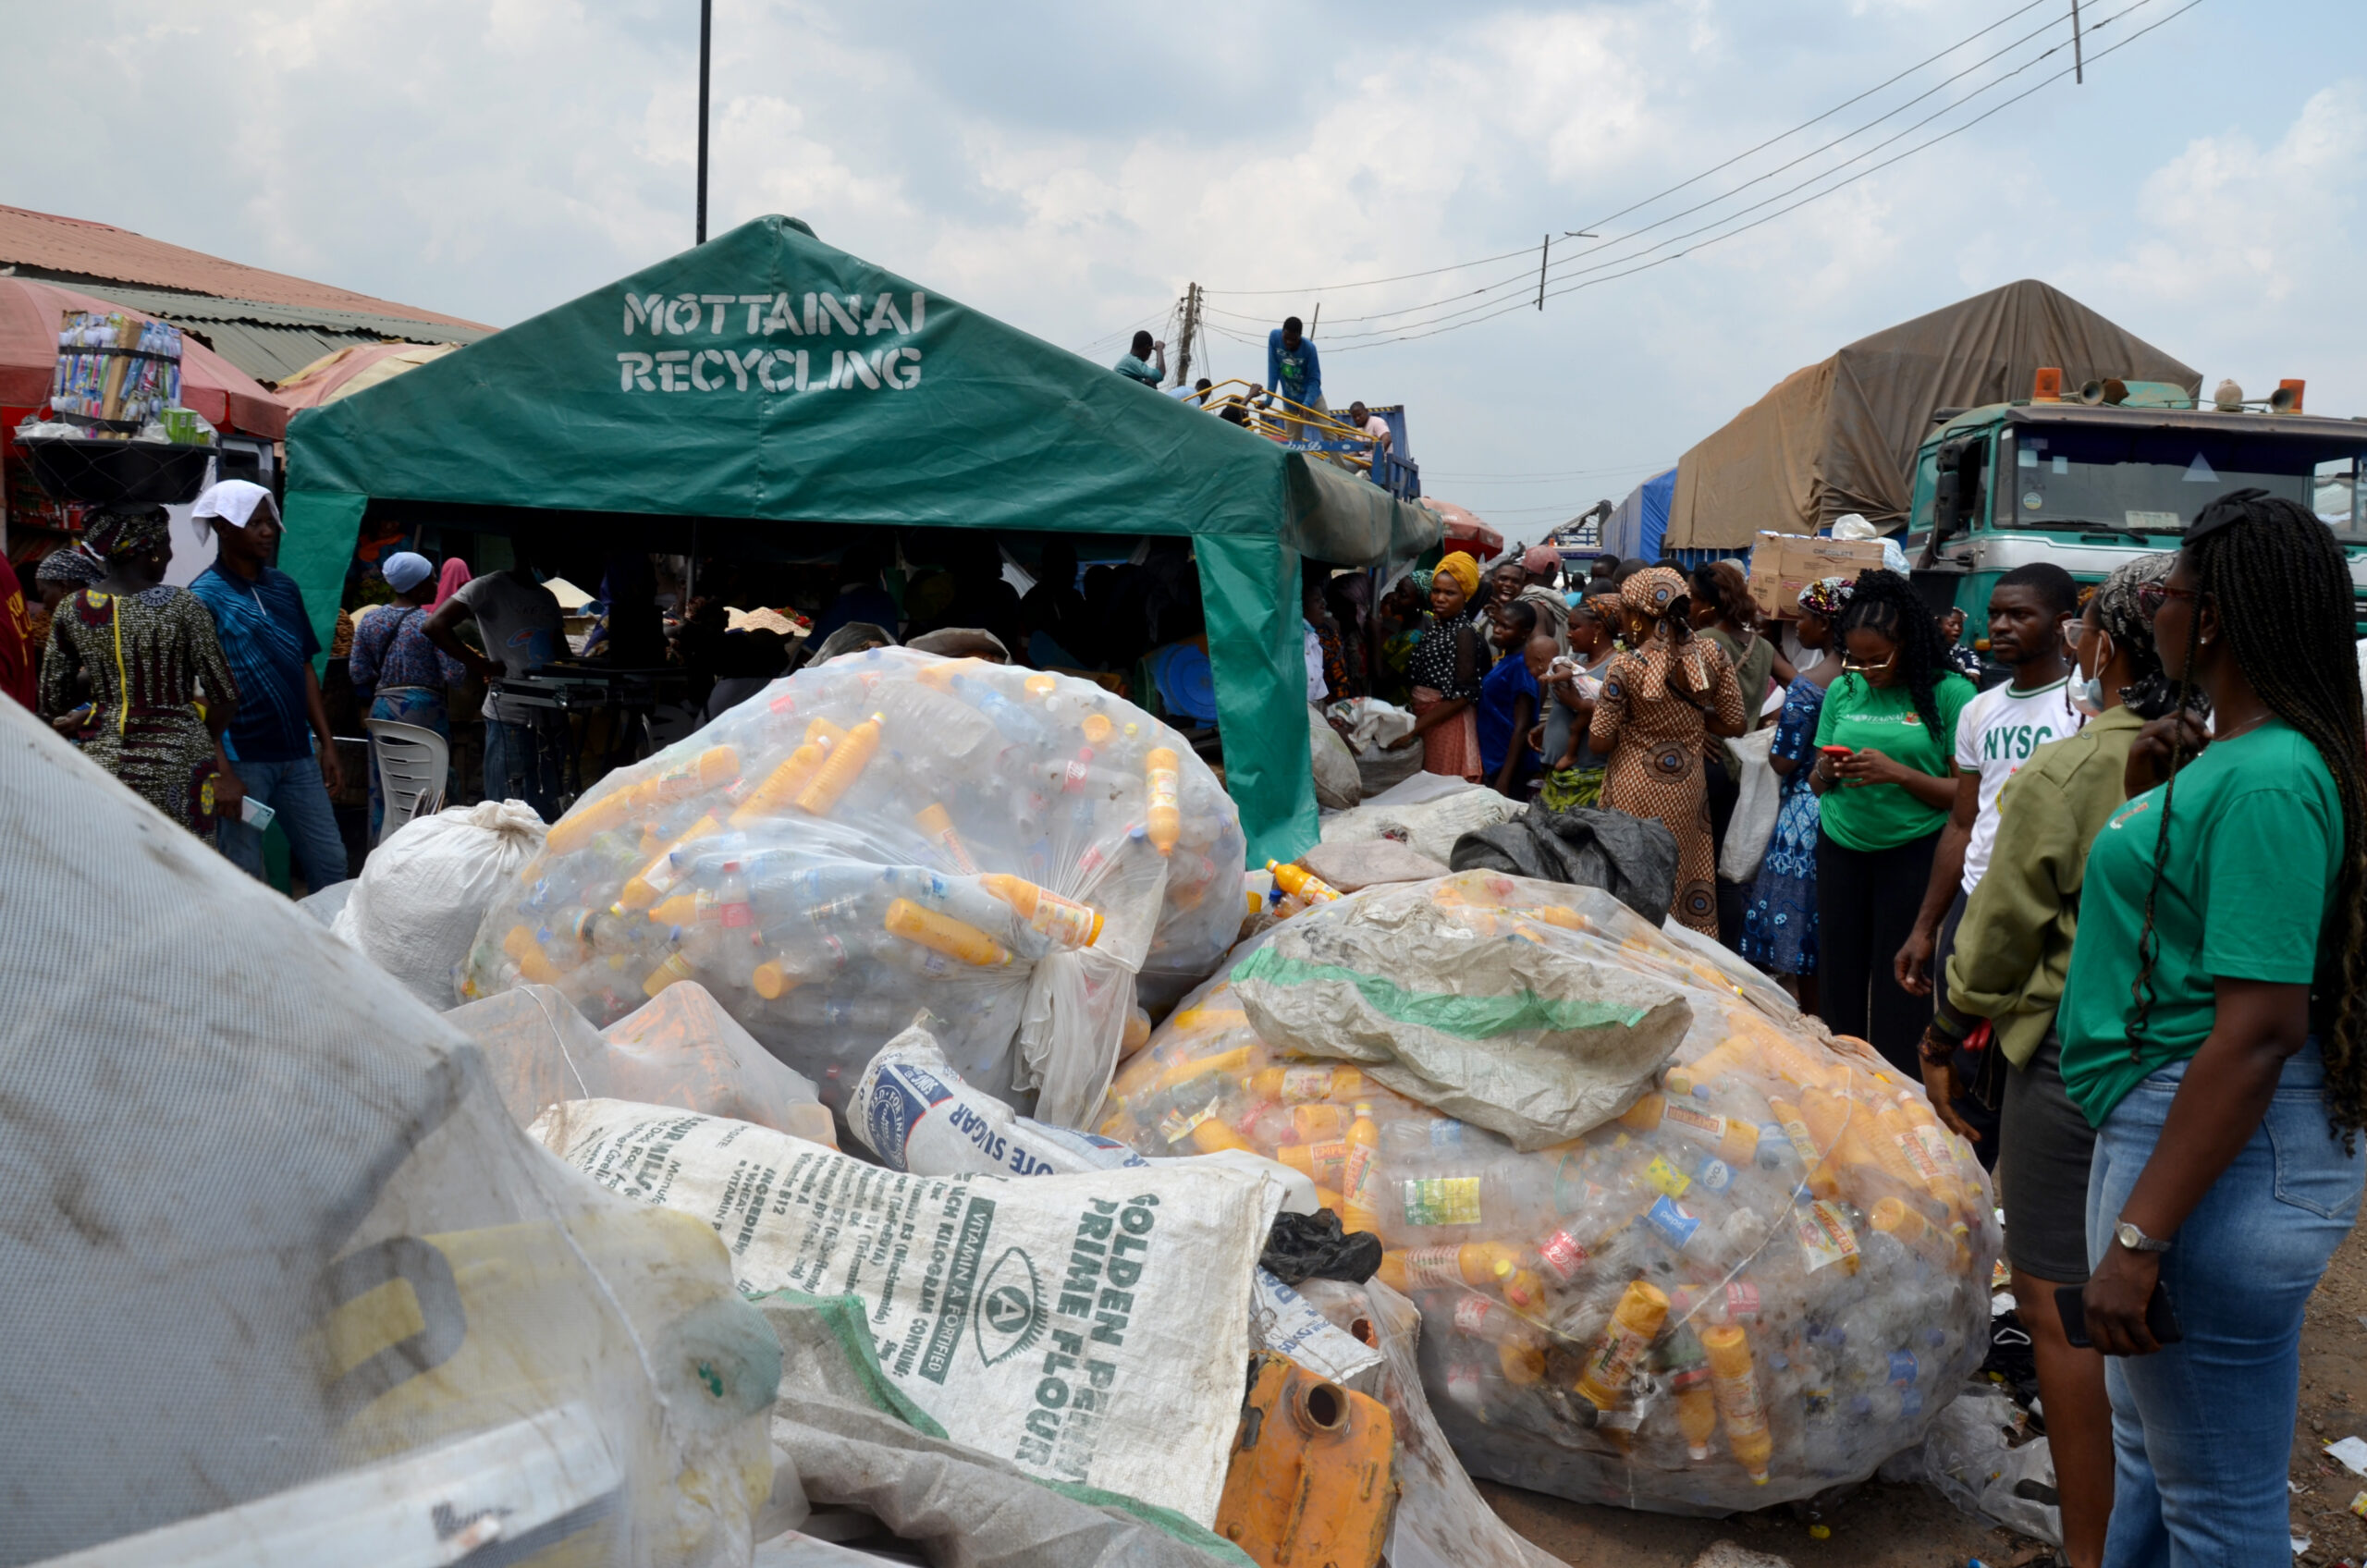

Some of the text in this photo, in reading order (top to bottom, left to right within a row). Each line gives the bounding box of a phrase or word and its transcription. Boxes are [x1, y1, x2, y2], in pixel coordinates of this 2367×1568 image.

[622, 291, 926, 336] MOTTAINAI
[617, 347, 923, 392] RECYCLING
[1984, 724, 2053, 761] NYSC
[948, 1102, 1007, 1161] SUGAR
[1665, 1102, 1723, 1134] EMPEROR
[1312, 1140, 1347, 1162] EMPE
[715, 1169, 744, 1220] VITAMIN
[734, 1172, 758, 1215] WHEAT
[1704, 1163, 1724, 1191] eva
[773, 1189, 792, 1216] B12
[795, 1194, 810, 1206] A
[812, 1202, 828, 1220] B9
[899, 1222, 915, 1241] B3
[1659, 1207, 1689, 1231] pepsi
[917, 1222, 955, 1315] KILOGRAM
[926, 1212, 987, 1373] VITAMIN A FORTIFIED
[991, 1290, 1027, 1325] A
[1014, 1196, 1120, 1466] PRIME FLOUR
